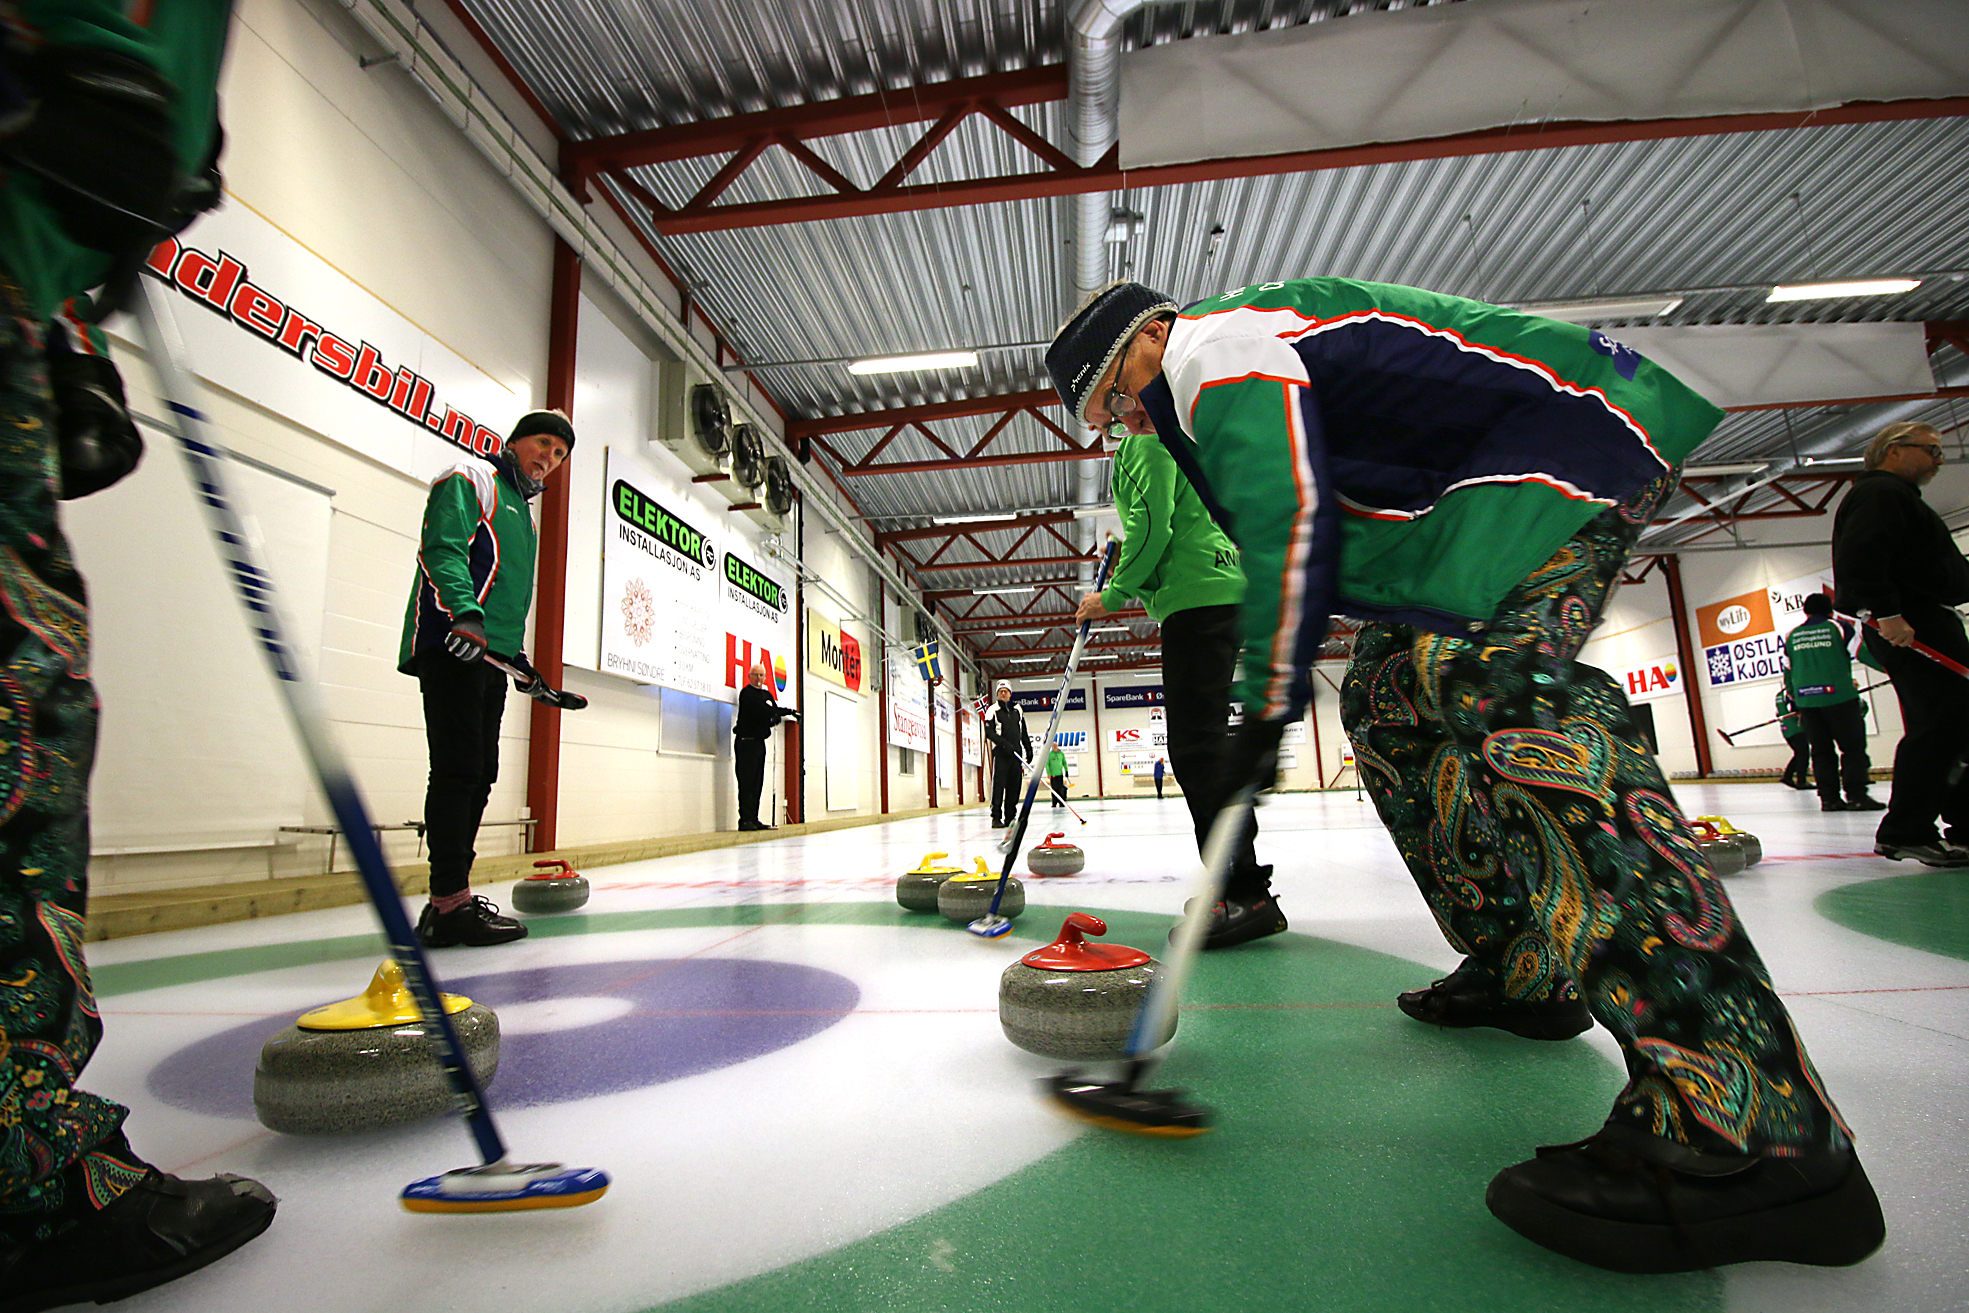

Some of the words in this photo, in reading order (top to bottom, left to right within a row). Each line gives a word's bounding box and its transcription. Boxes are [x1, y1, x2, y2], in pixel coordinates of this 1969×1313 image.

[619, 484, 702, 561] ELEKTOR
[619, 523, 688, 575] INSTALLASJON
[690, 566, 701, 582] AS
[727, 555, 779, 607] ELEKTOR
[727, 586, 771, 620] INSTALLASJON
[771, 612, 779, 624] AS
[607, 652, 637, 673] BRYHNI
[637, 661, 665, 681] SØNDRE
[821, 629, 860, 681] Montér
[1106, 693, 1144, 703] SpareBank
[1116, 729, 1140, 742] KS
